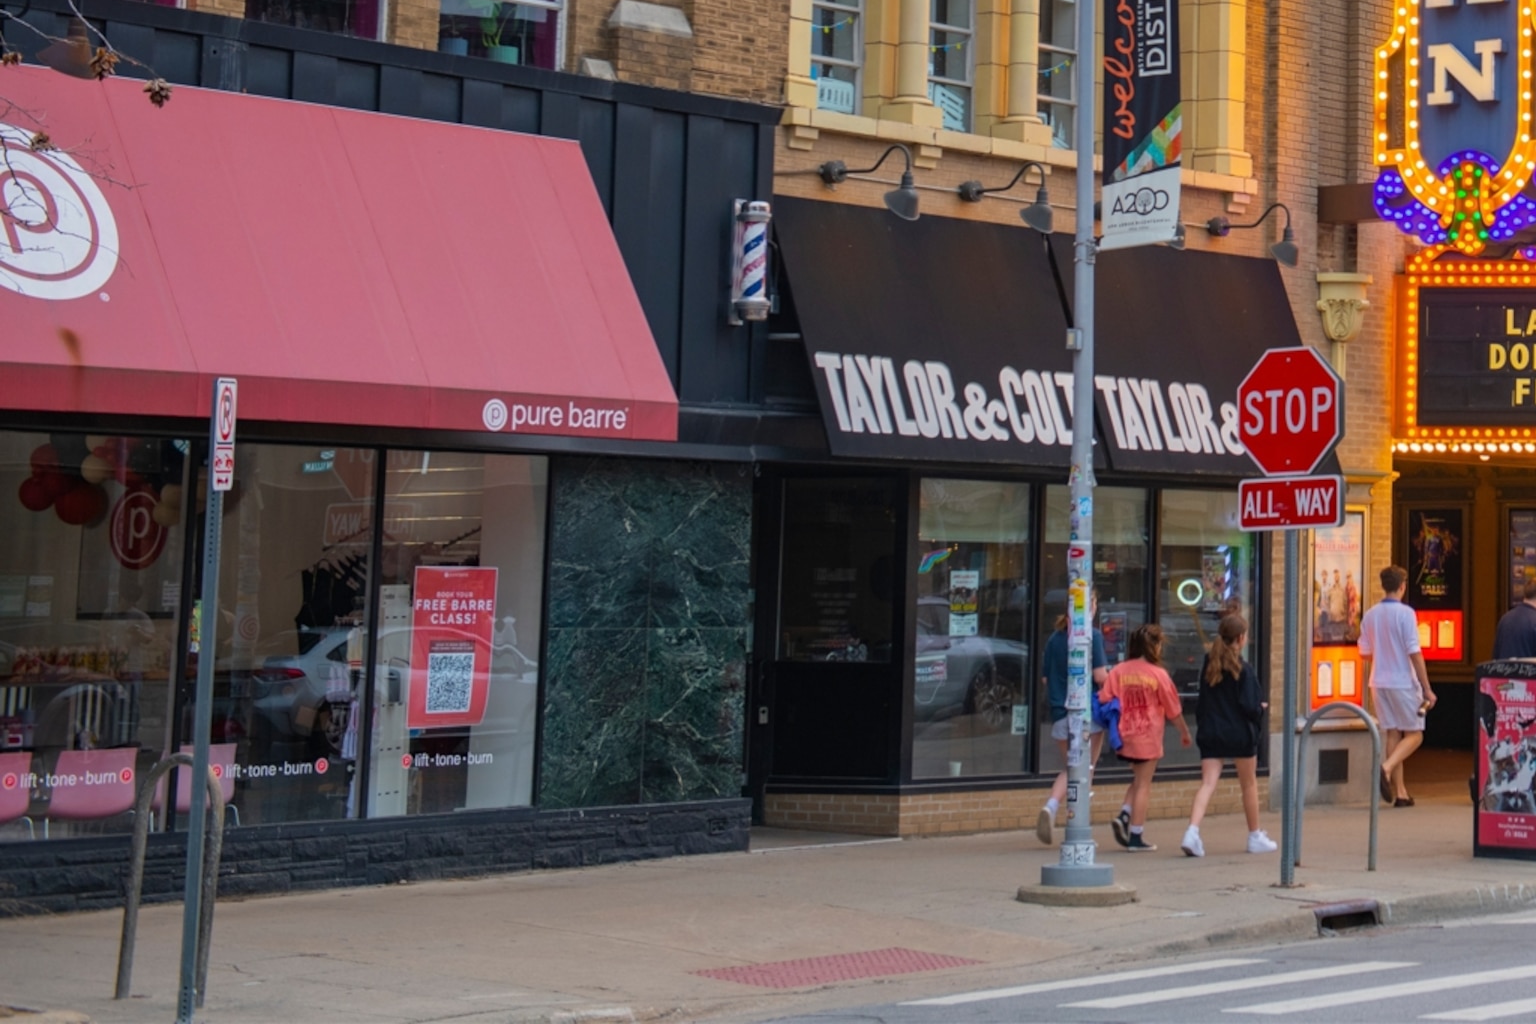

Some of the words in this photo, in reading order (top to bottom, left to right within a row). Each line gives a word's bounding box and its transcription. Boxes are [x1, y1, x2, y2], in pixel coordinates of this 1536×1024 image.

[512, 404, 563, 431] pure
[568, 401, 626, 430] barre
[1243, 386, 1333, 436] STOP
[1243, 490, 1280, 519] ALL
[1294, 487, 1334, 517] WAY
[415, 599, 447, 611] FREE
[451, 599, 493, 611] BARRE
[430, 613, 477, 625] CLASS!
